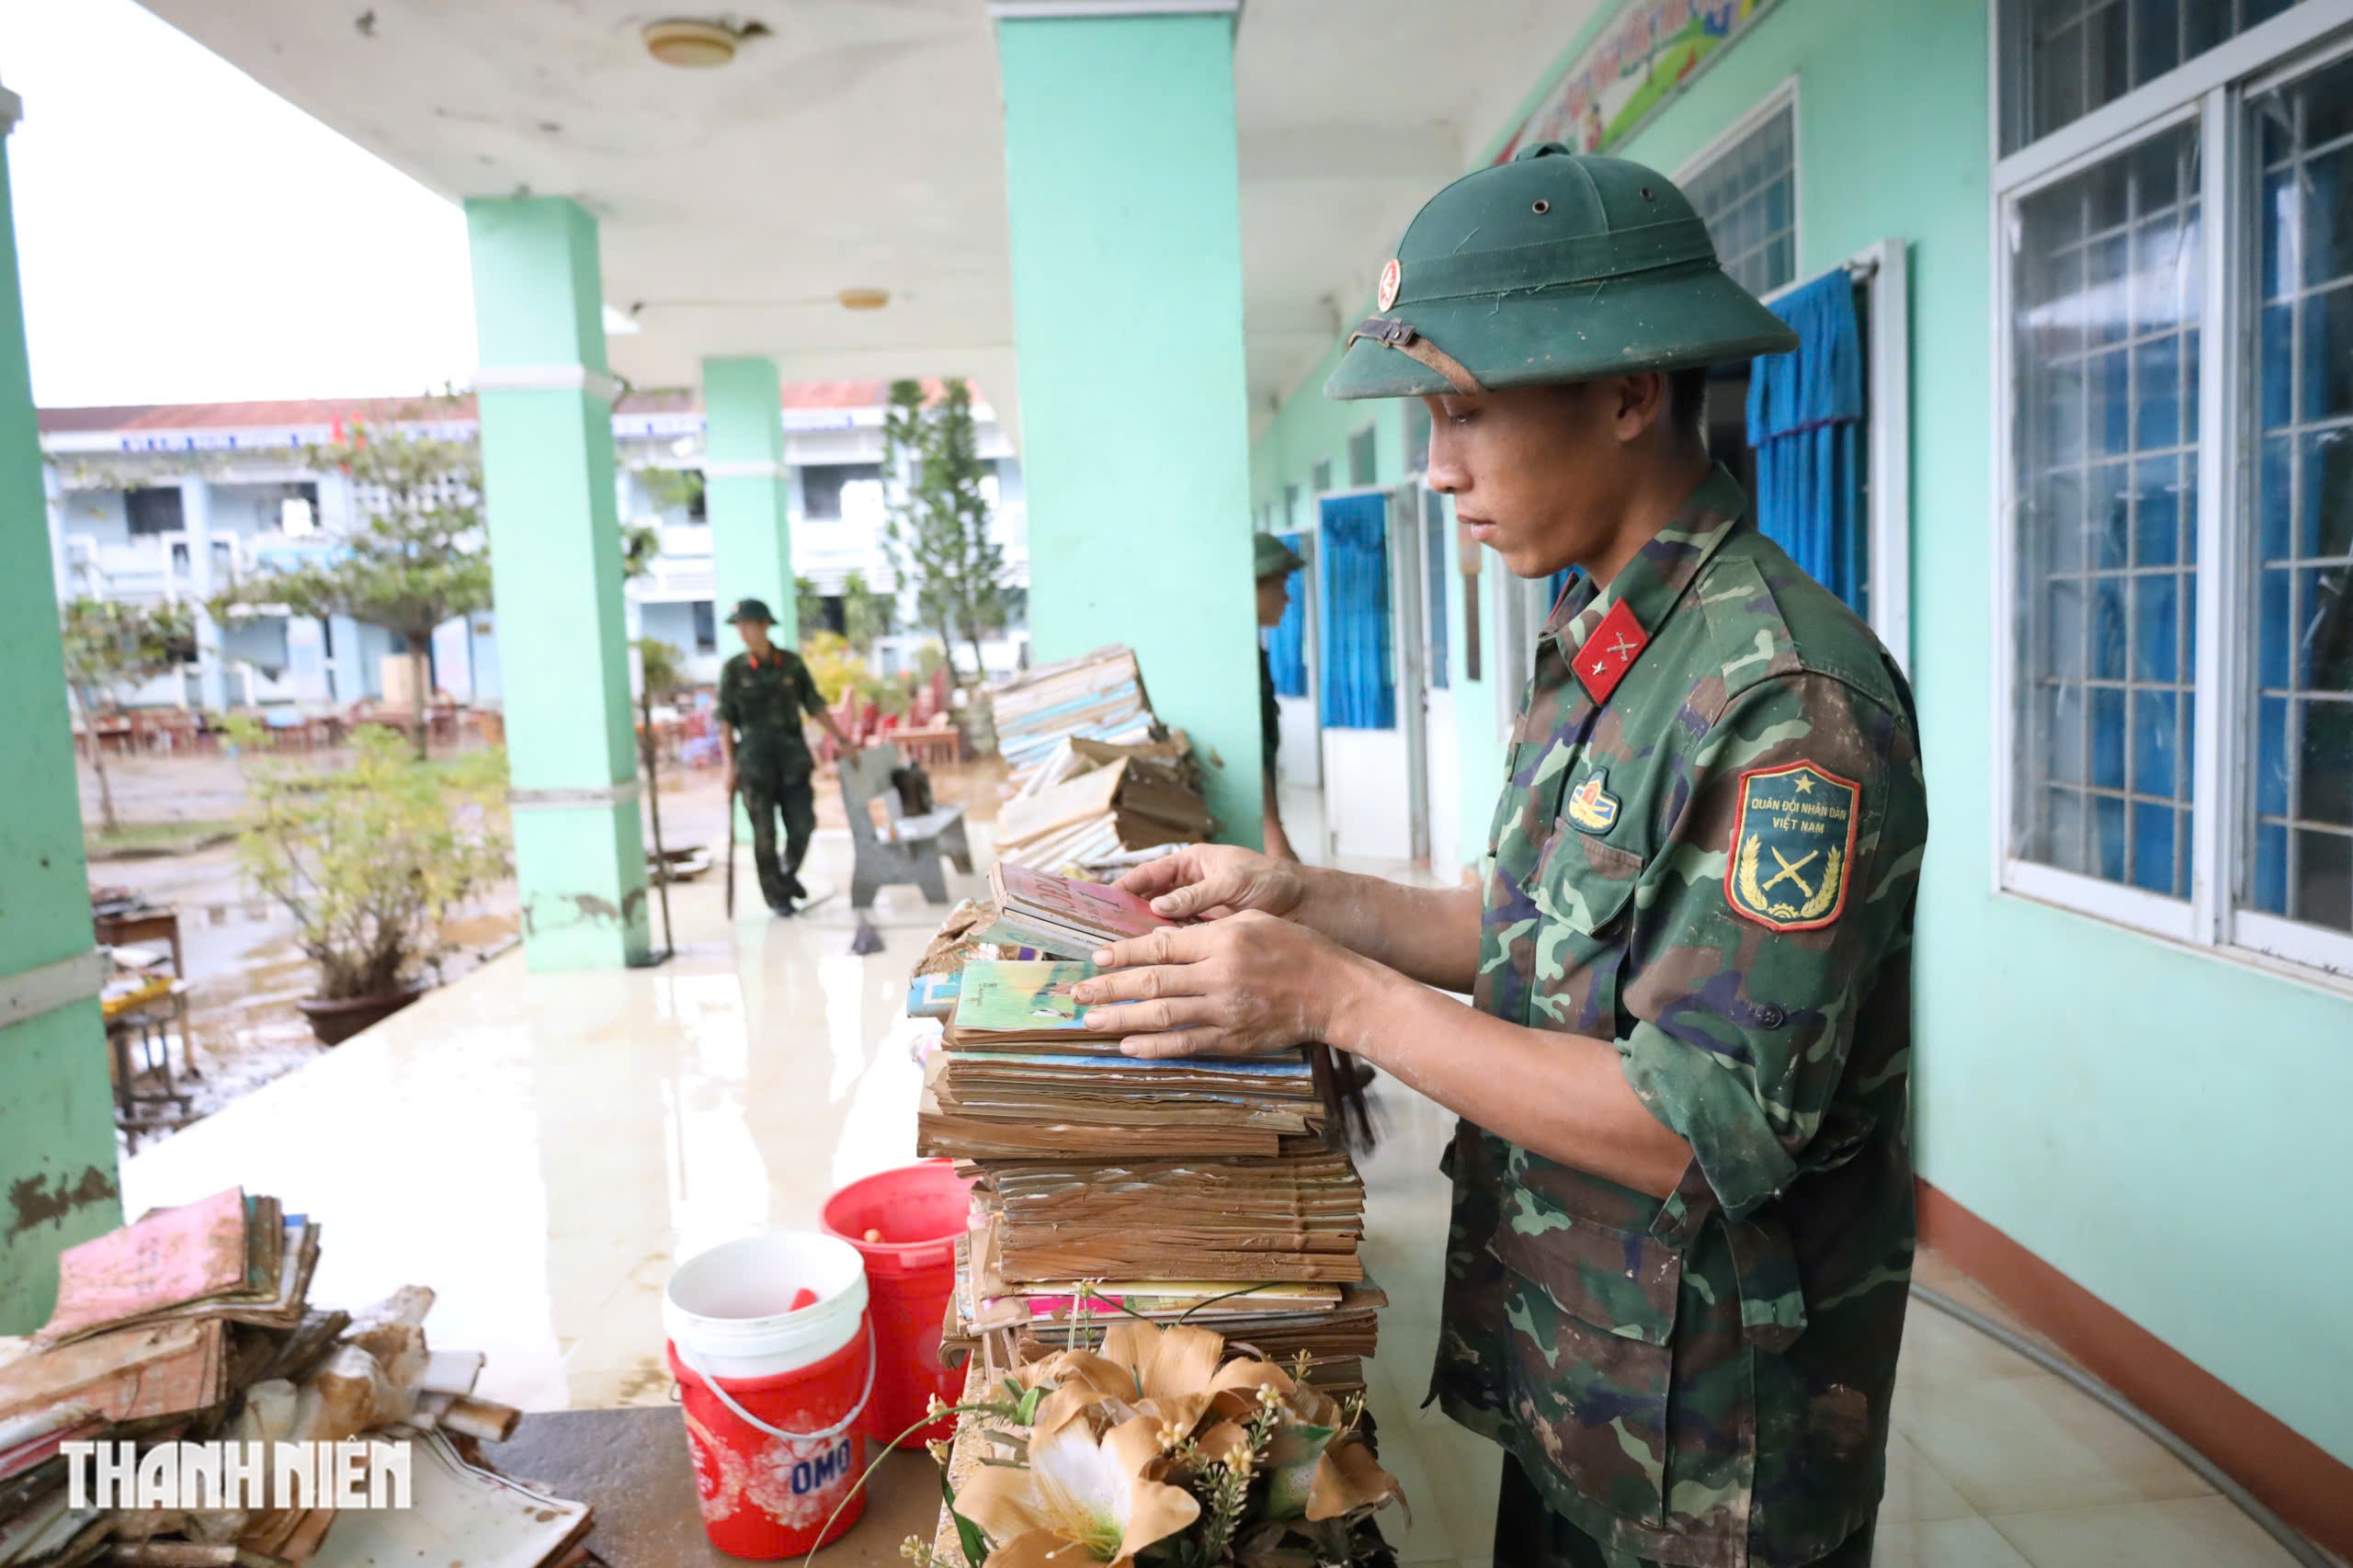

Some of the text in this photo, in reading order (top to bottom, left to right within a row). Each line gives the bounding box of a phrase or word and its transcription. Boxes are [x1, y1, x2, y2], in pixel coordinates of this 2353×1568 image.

[1751, 797, 1779, 810] QUÂN
[1781, 800, 1800, 814] ĐỘI
[1802, 801, 1828, 816] NHÂN
[1772, 814, 1824, 833] VIỆT NAM
[791, 1438, 850, 1494] OMO
